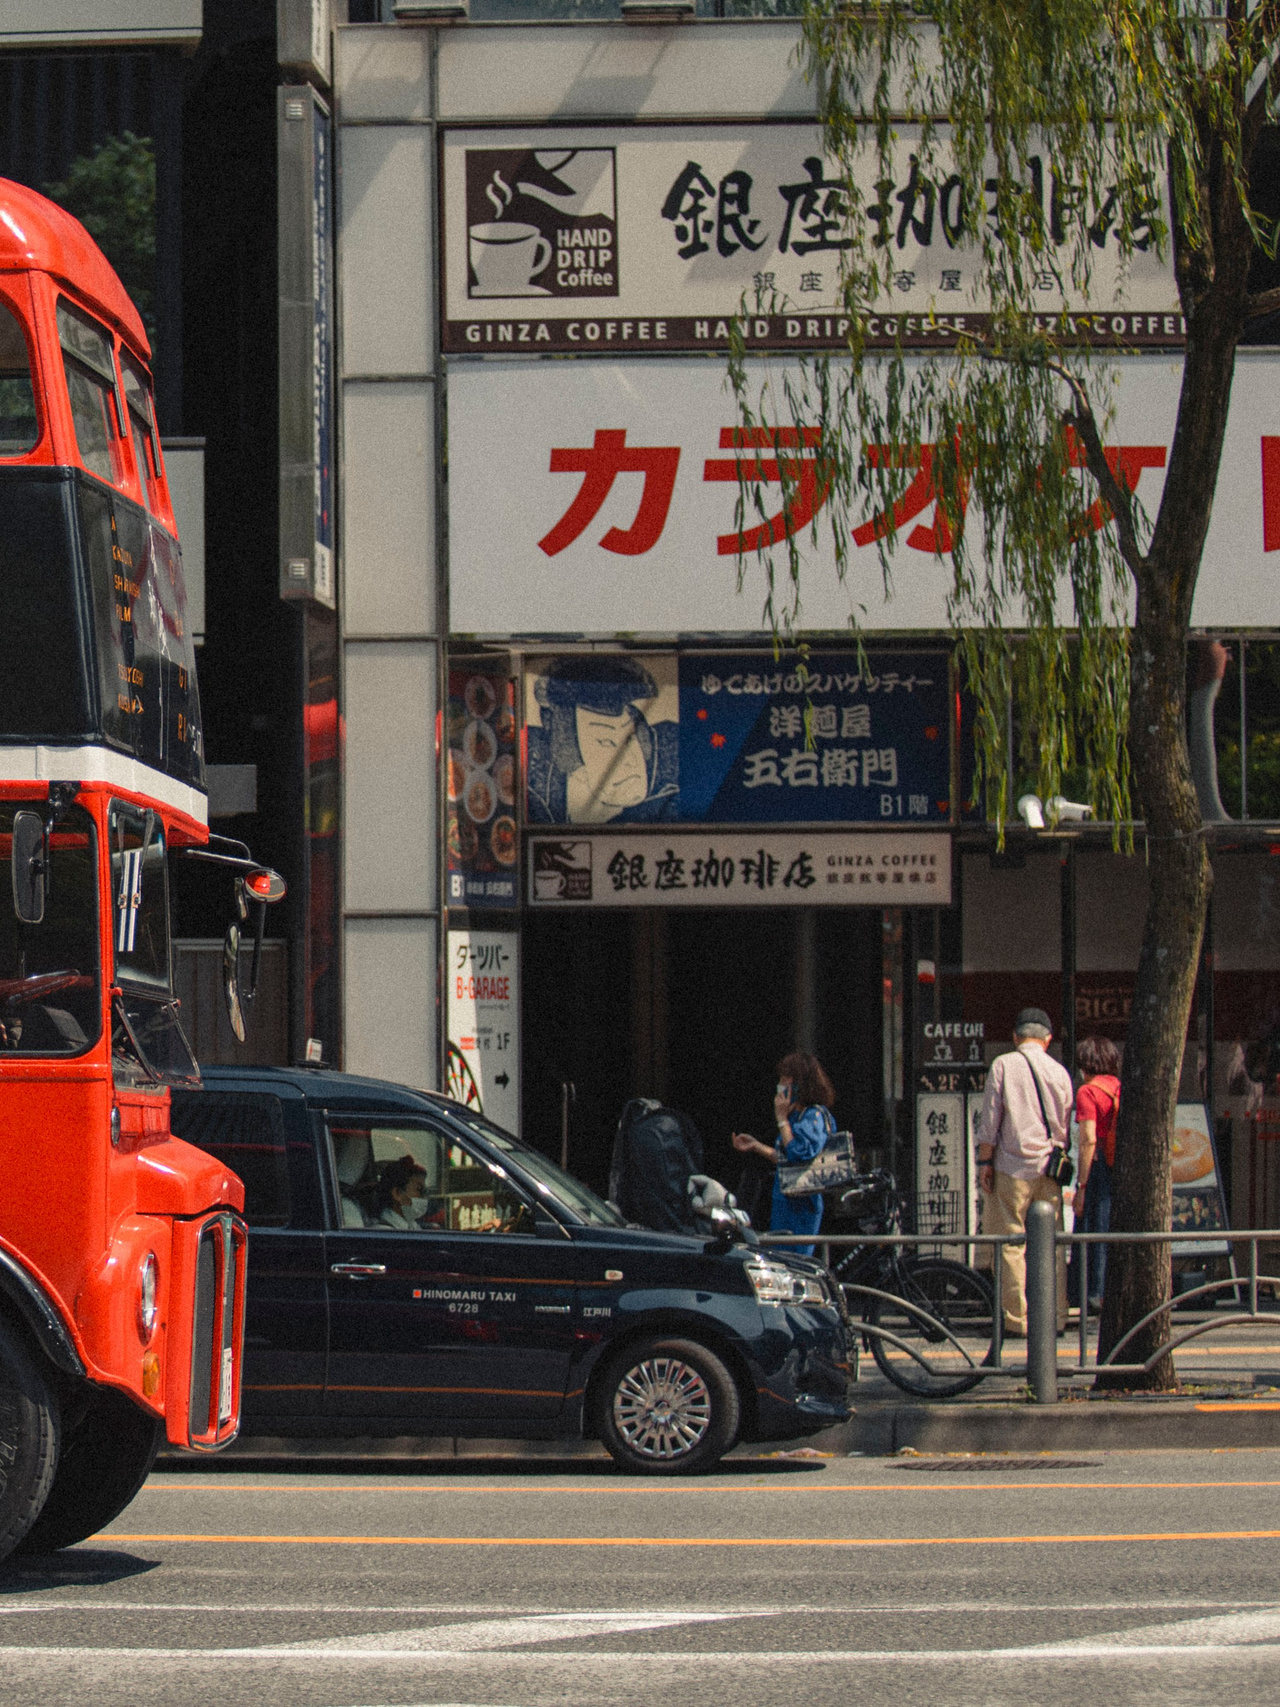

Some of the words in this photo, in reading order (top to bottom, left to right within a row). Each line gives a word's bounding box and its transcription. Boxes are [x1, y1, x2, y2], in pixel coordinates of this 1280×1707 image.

[557, 228, 612, 248] HAND
[557, 249, 612, 268] DRIP
[557, 269, 613, 287] Coffee
[466, 322, 551, 342] GINZA
[567, 321, 668, 340] COFFEE
[695, 320, 769, 339] HAND
[786, 319, 850, 337] DRIP
[866, 317, 966, 336] COFFEE
[537, 423, 1167, 558] カラオケ
[743, 748, 898, 788] 五右衛門
[606, 848, 817, 892] 銀座珈琲店
[826, 854, 874, 867] GINZA
[881, 854, 937, 867] COFFEE
[456, 944, 510, 971] ダーツバー
[456, 976, 510, 1001] B-GARAGE
[923, 1023, 962, 1039] CAFE
[422, 1289, 487, 1301] HINOMARU
[490, 1291, 517, 1302] TAXI
[448, 1302, 480, 1314] 6728
